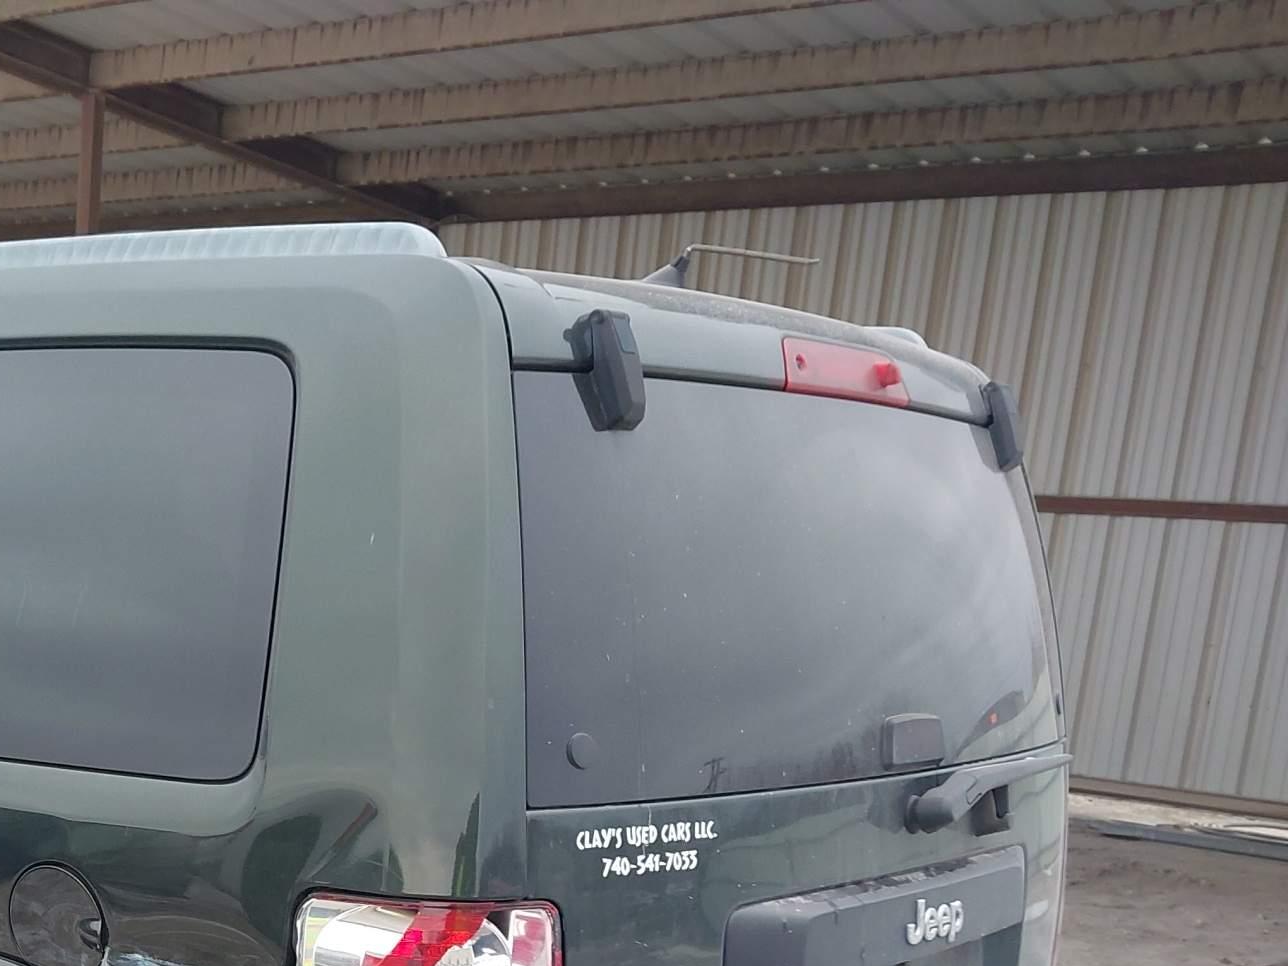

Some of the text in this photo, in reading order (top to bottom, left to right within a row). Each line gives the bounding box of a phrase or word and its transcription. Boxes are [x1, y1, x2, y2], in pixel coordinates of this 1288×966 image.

[575, 826, 623, 850] CLAY'S
[625, 824, 658, 847] USED
[661, 821, 692, 843] CARS
[601, 849, 698, 878] 740-541-7033
[906, 898, 964, 945] Jeep
